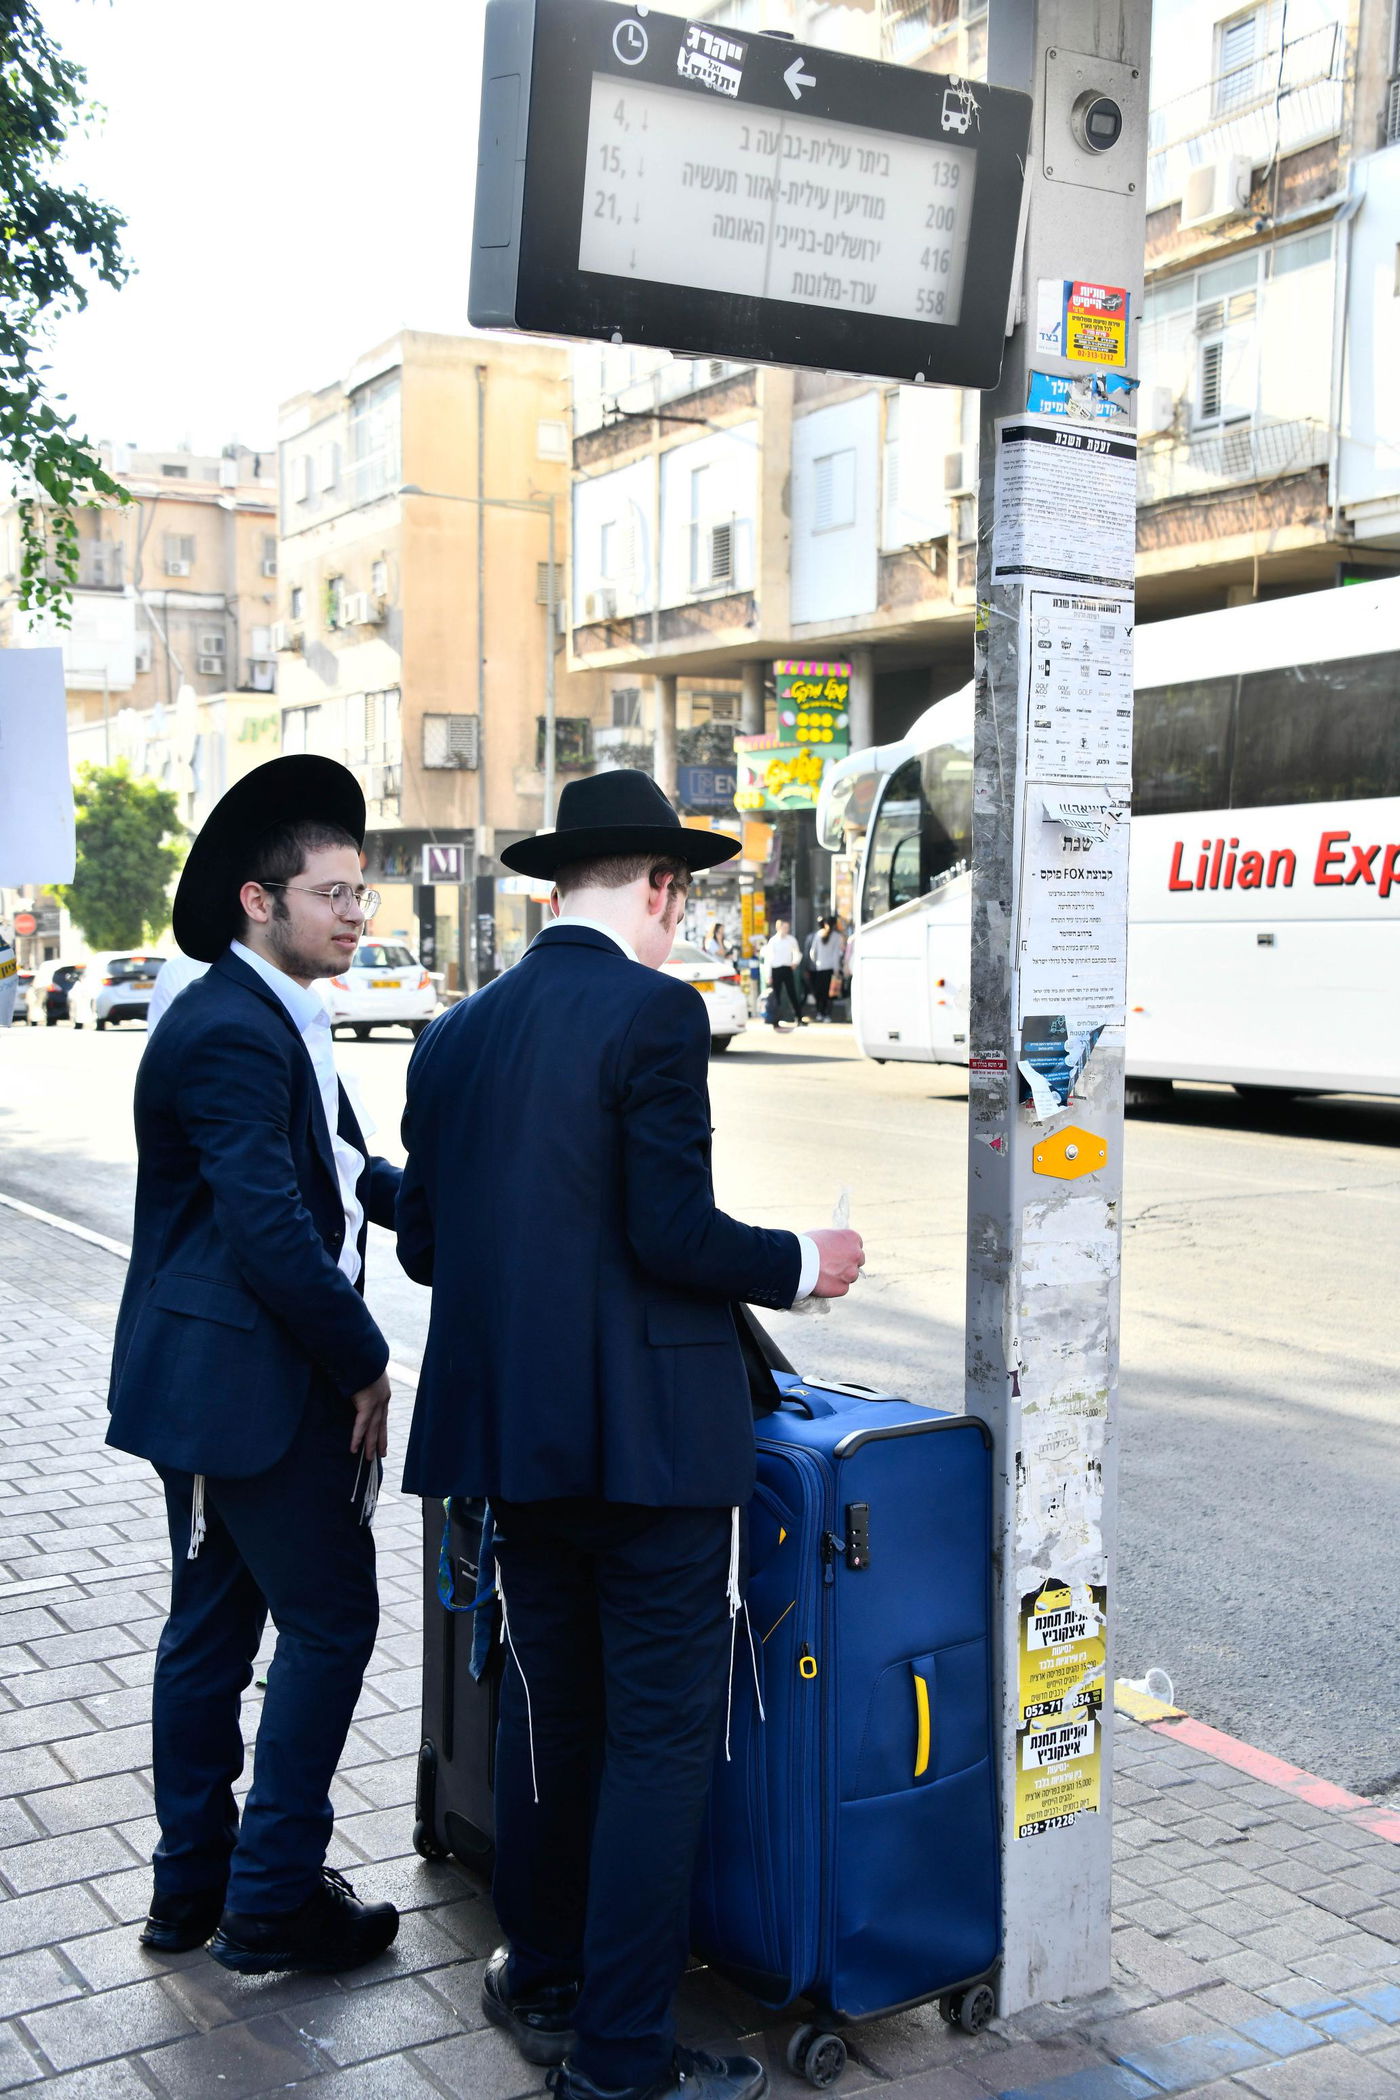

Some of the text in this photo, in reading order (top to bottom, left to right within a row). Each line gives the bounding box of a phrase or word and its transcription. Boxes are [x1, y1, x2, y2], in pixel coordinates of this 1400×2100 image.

[708, 60, 721, 73] ואל
[857, 147, 891, 177] ביתר
[682, 161, 738, 195] תעשיה
[932, 161, 961, 189] 139
[833, 189, 886, 221] מודיעין
[713, 213, 766, 245] האומה
[925, 204, 956, 233] 200
[920, 247, 950, 274] 416
[915, 288, 946, 316] 558
[1077, 350, 1114, 361] 02-313-1212
[1055, 432, 1111, 454] זעקת השבת
[1053, 599, 1069, 608] שבת
[1040, 868, 1113, 881] קבוצת FOX פוקס
[1168, 837, 1297, 892] Lilian
[1035, 1613, 1061, 1631] תחנת
[1042, 1623, 1085, 1646] איצקוביץ
[1030, 1732, 1057, 1750] תחנת
[1038, 1741, 1081, 1765] איצקוביץ
